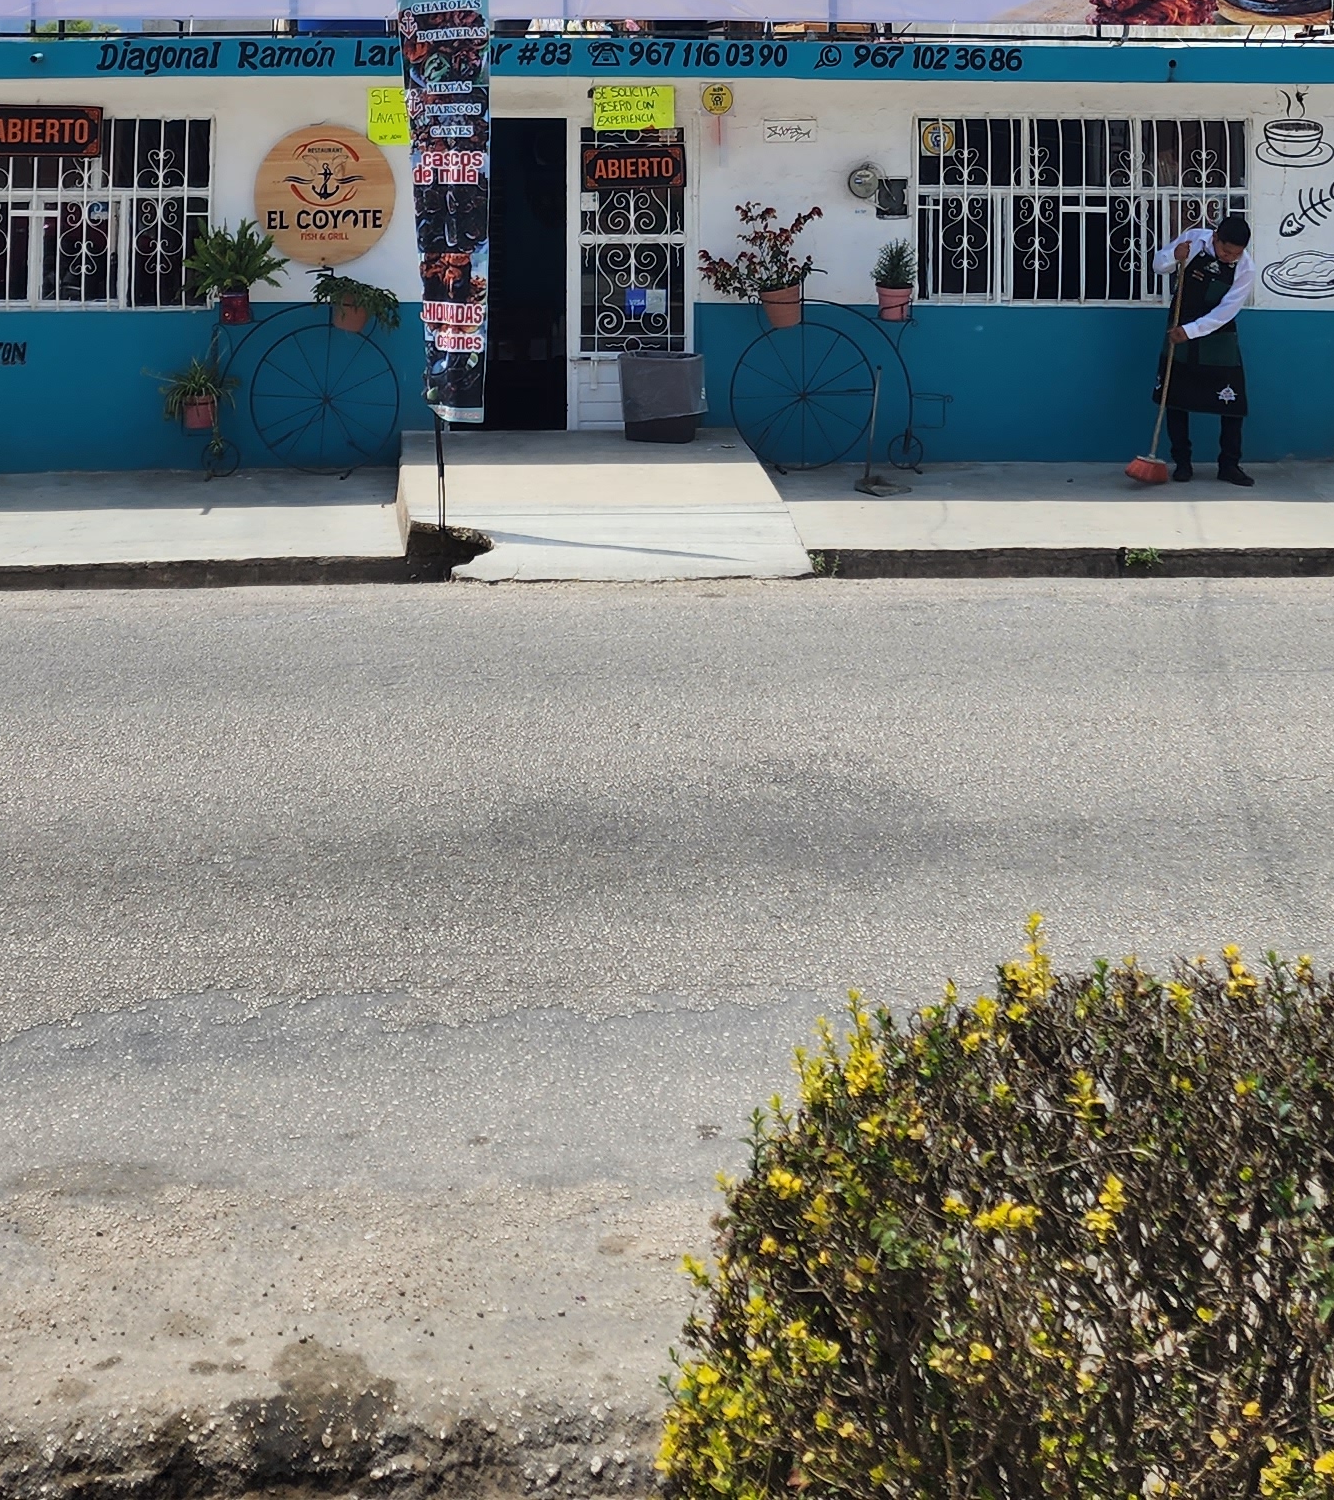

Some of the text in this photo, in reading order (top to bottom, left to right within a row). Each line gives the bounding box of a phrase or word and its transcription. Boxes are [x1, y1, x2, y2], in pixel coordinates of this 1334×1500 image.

[412, 0, 481, 13] CHAROLAS
[418, 27, 486, 41] BOTANERAS
[96, 41, 222, 75] Diagonal
[238, 40, 336, 70] Ramón
[517, 42, 573, 66] #83
[629, 41, 676, 67] 967
[682, 42, 720, 67] 116
[853, 44, 904, 69] 967
[912, 46, 950, 70] 102
[954, 47, 1023, 72] 3686
[427, 83, 471, 94] MIXTAS
[610, 86, 659, 98] SOLICITA
[371, 90, 391, 105] SE
[594, 100, 655, 113] MESERO CON
[596, 113, 656, 126] EXPERIENCIA
[423, 152, 483, 167] cascos
[413, 164, 432, 183] de
[594, 157, 674, 180] ABIERTO
[267, 209, 383, 229] EL COYOTE
[301, 232, 317, 240] FISH
[328, 232, 349, 240] GRILL
